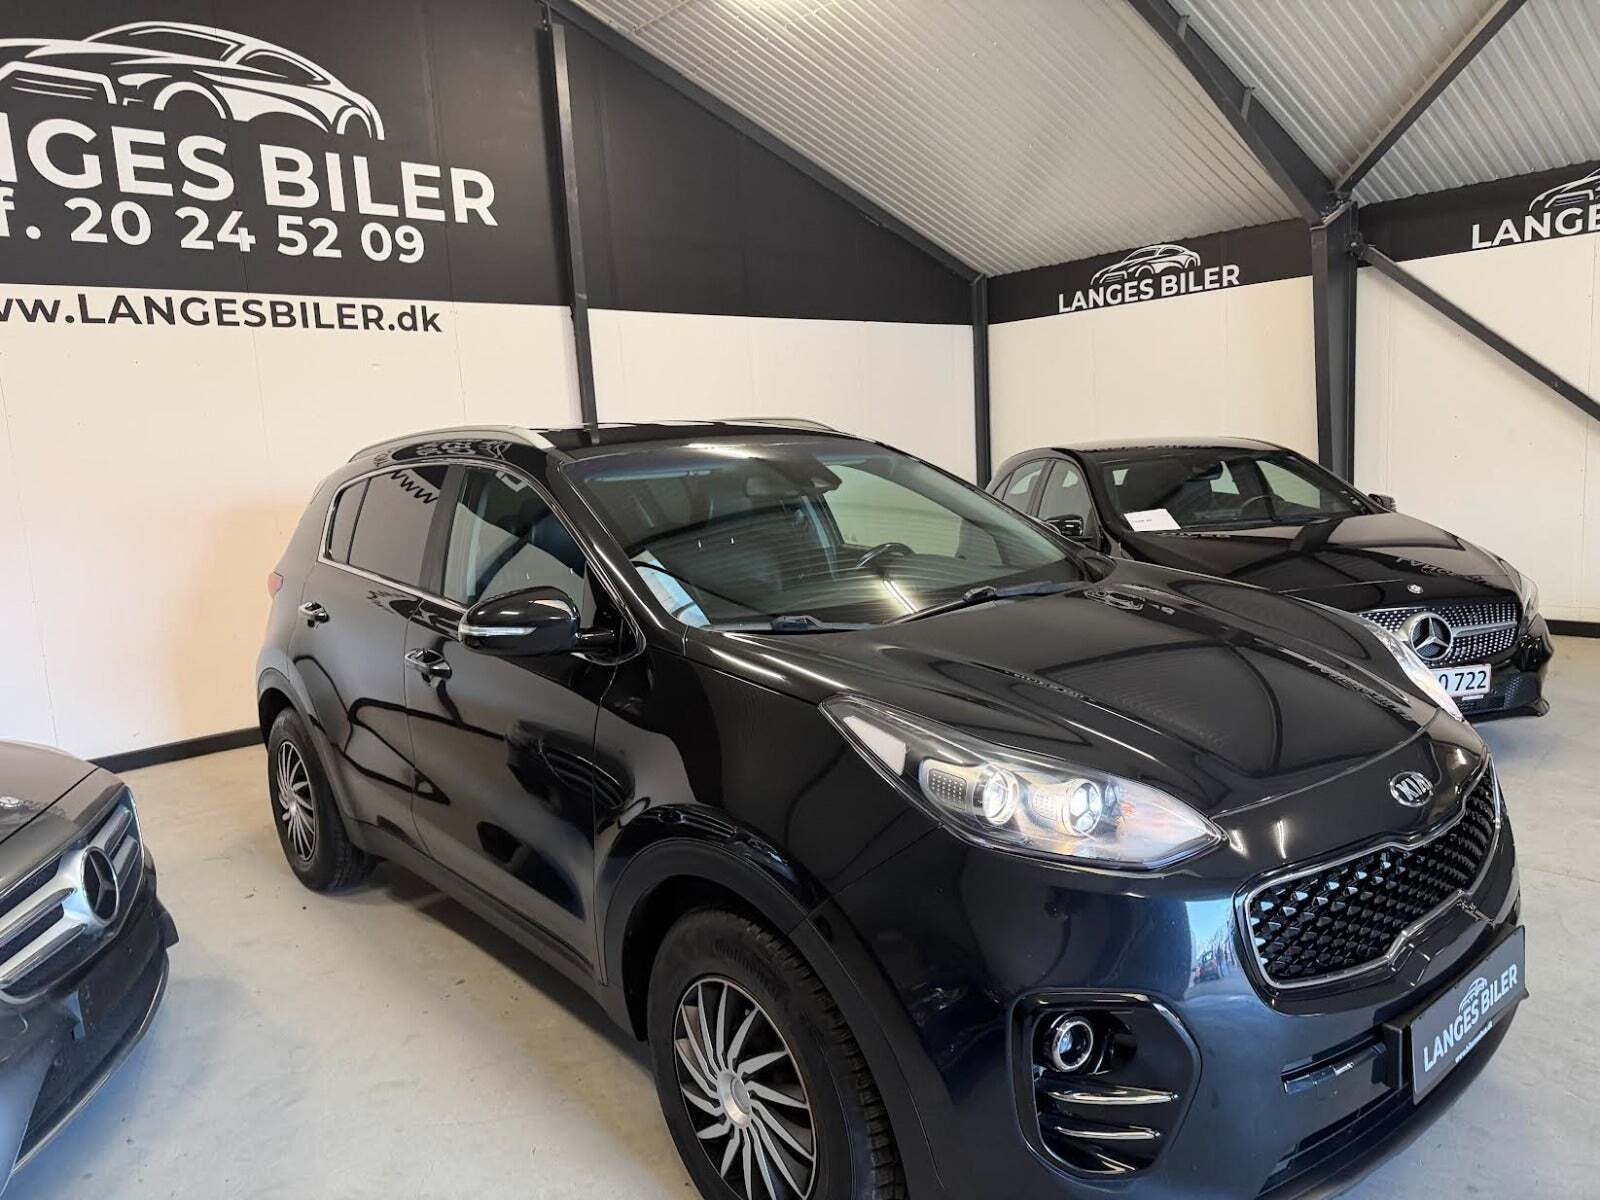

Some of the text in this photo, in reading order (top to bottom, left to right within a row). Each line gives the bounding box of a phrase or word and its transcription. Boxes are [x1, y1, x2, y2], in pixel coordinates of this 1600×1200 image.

[0, 111, 499, 227] GES BILER
[64, 197, 152, 246] 20
[174, 206, 257, 253] 24
[277, 214, 343, 259] 52
[360, 222, 425, 264] 09
[1058, 264, 1240, 313] LANGES BILER
[1454, 670, 1487, 692] 722
[1423, 999, 1480, 1073] LANGES
[1480, 963, 1518, 1015] BILER
